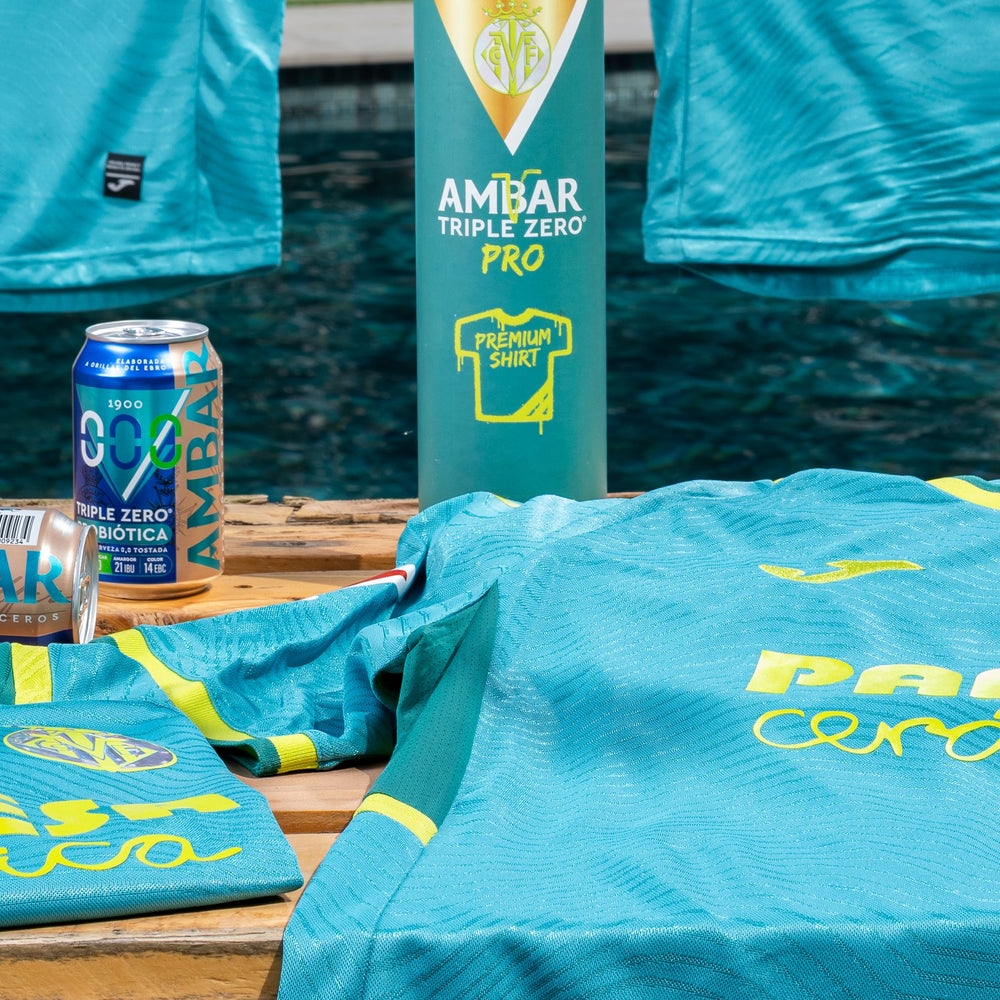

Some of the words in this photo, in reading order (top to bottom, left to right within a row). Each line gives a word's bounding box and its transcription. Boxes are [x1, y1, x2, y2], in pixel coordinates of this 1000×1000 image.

[438, 177, 583, 215] AMBAR
[437, 216, 515, 238] TRIPLE
[481, 243, 545, 277] PRO
[475, 328, 551, 351] PREMIUM
[489, 348, 541, 369] SHIRT
[108, 399, 143, 411] 1900
[183, 339, 221, 571] AMBAR
[76, 501, 116, 522] TRIPLE
[98, 545, 120, 553] RVEZA
[114, 562, 123, 572] 21
[124, 564, 135, 573] IBU
[144, 563, 153, 573] 14
[154, 564, 166, 573] EBC
[745, 649, 1000, 699] PA
